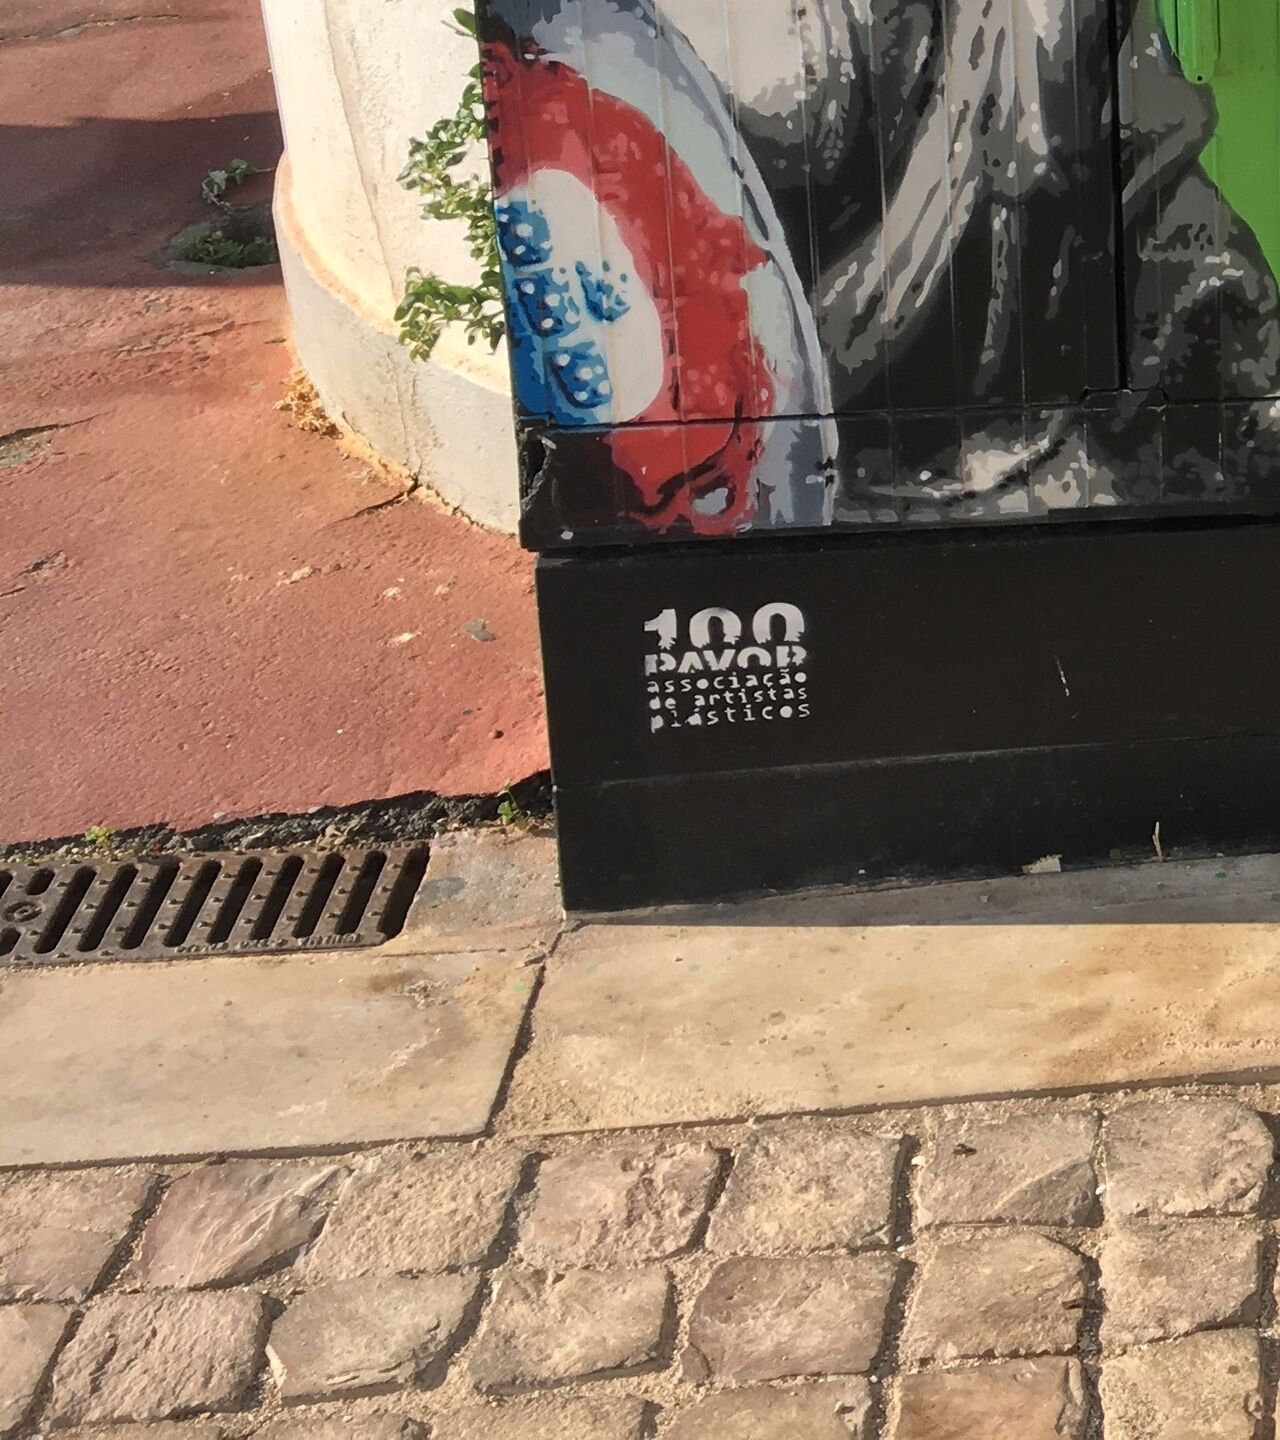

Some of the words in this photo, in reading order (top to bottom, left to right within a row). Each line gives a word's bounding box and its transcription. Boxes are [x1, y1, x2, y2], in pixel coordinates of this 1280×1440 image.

[644, 602, 805, 650] 100
[647, 668, 807, 693] associação
[649, 697, 677, 711] de
[694, 687, 808, 707] artistas
